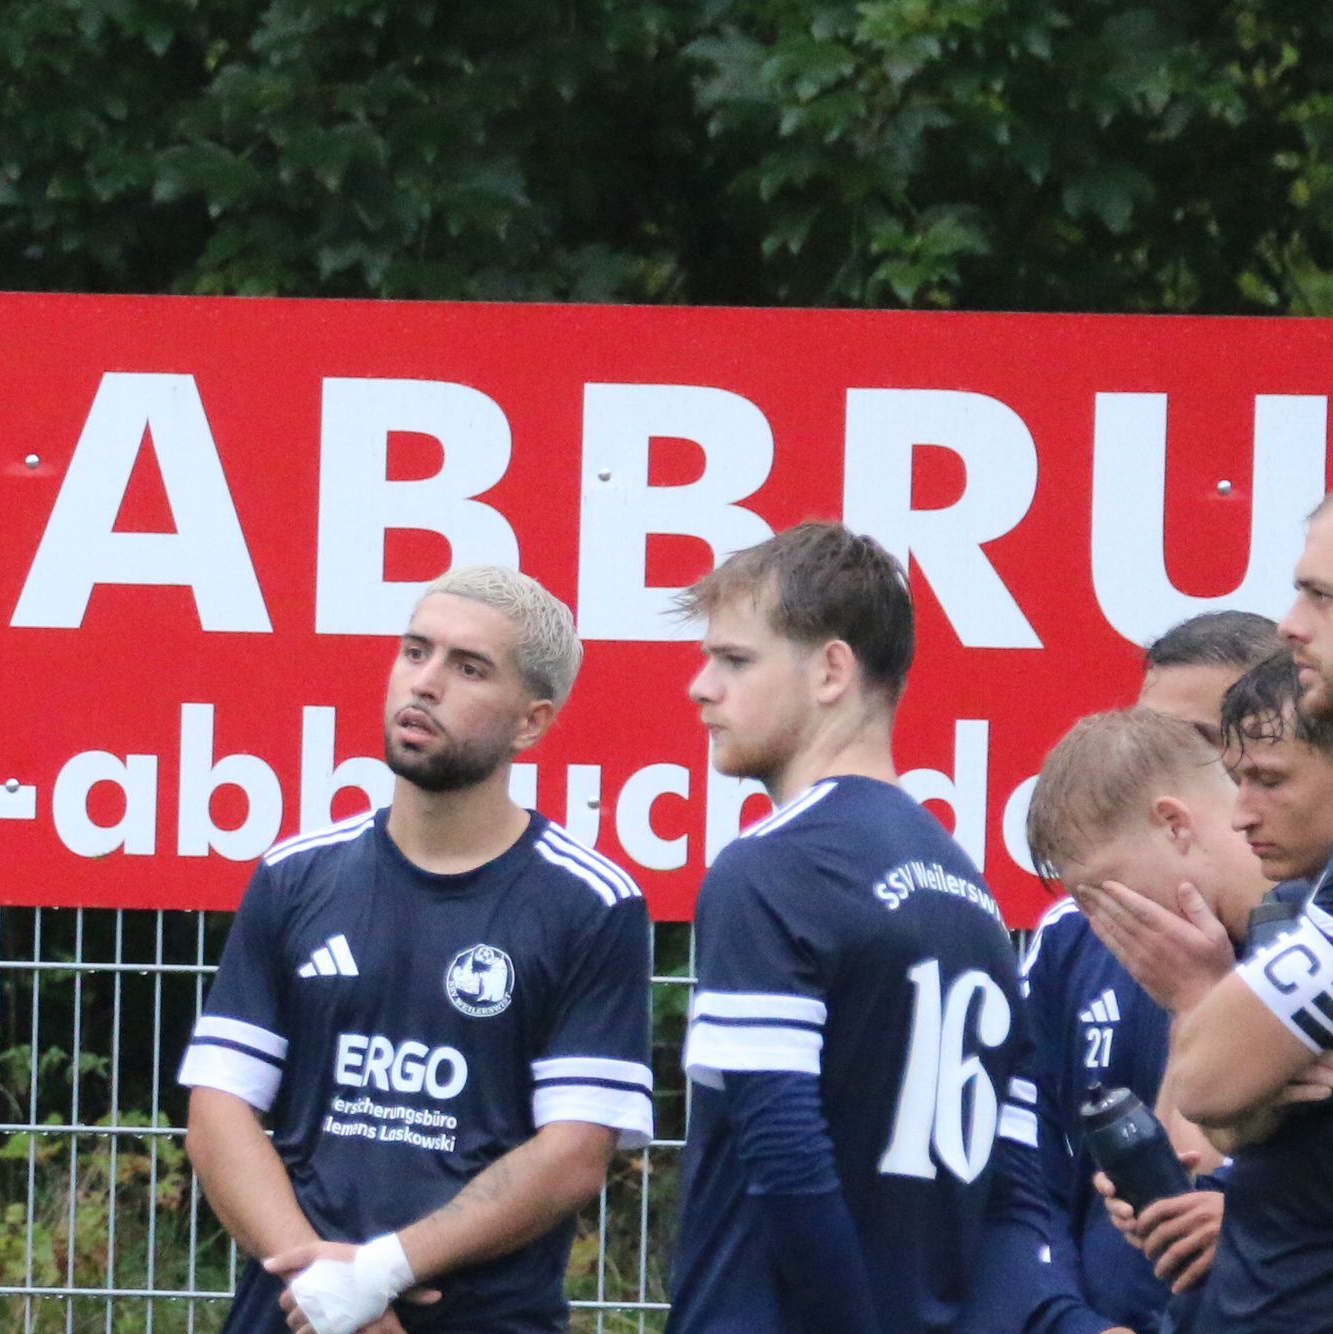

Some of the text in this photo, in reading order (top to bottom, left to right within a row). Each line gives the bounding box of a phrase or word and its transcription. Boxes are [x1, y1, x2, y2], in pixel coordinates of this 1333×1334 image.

[9, 371, 1329, 650] ABBRU
[876, 862, 916, 910] SSV
[335, 1033, 469, 1099] ERGO
[877, 959, 1011, 1184] 16
[1085, 1027, 1114, 1069] 21
[324, 1115, 457, 1153] lemens Laskowski
